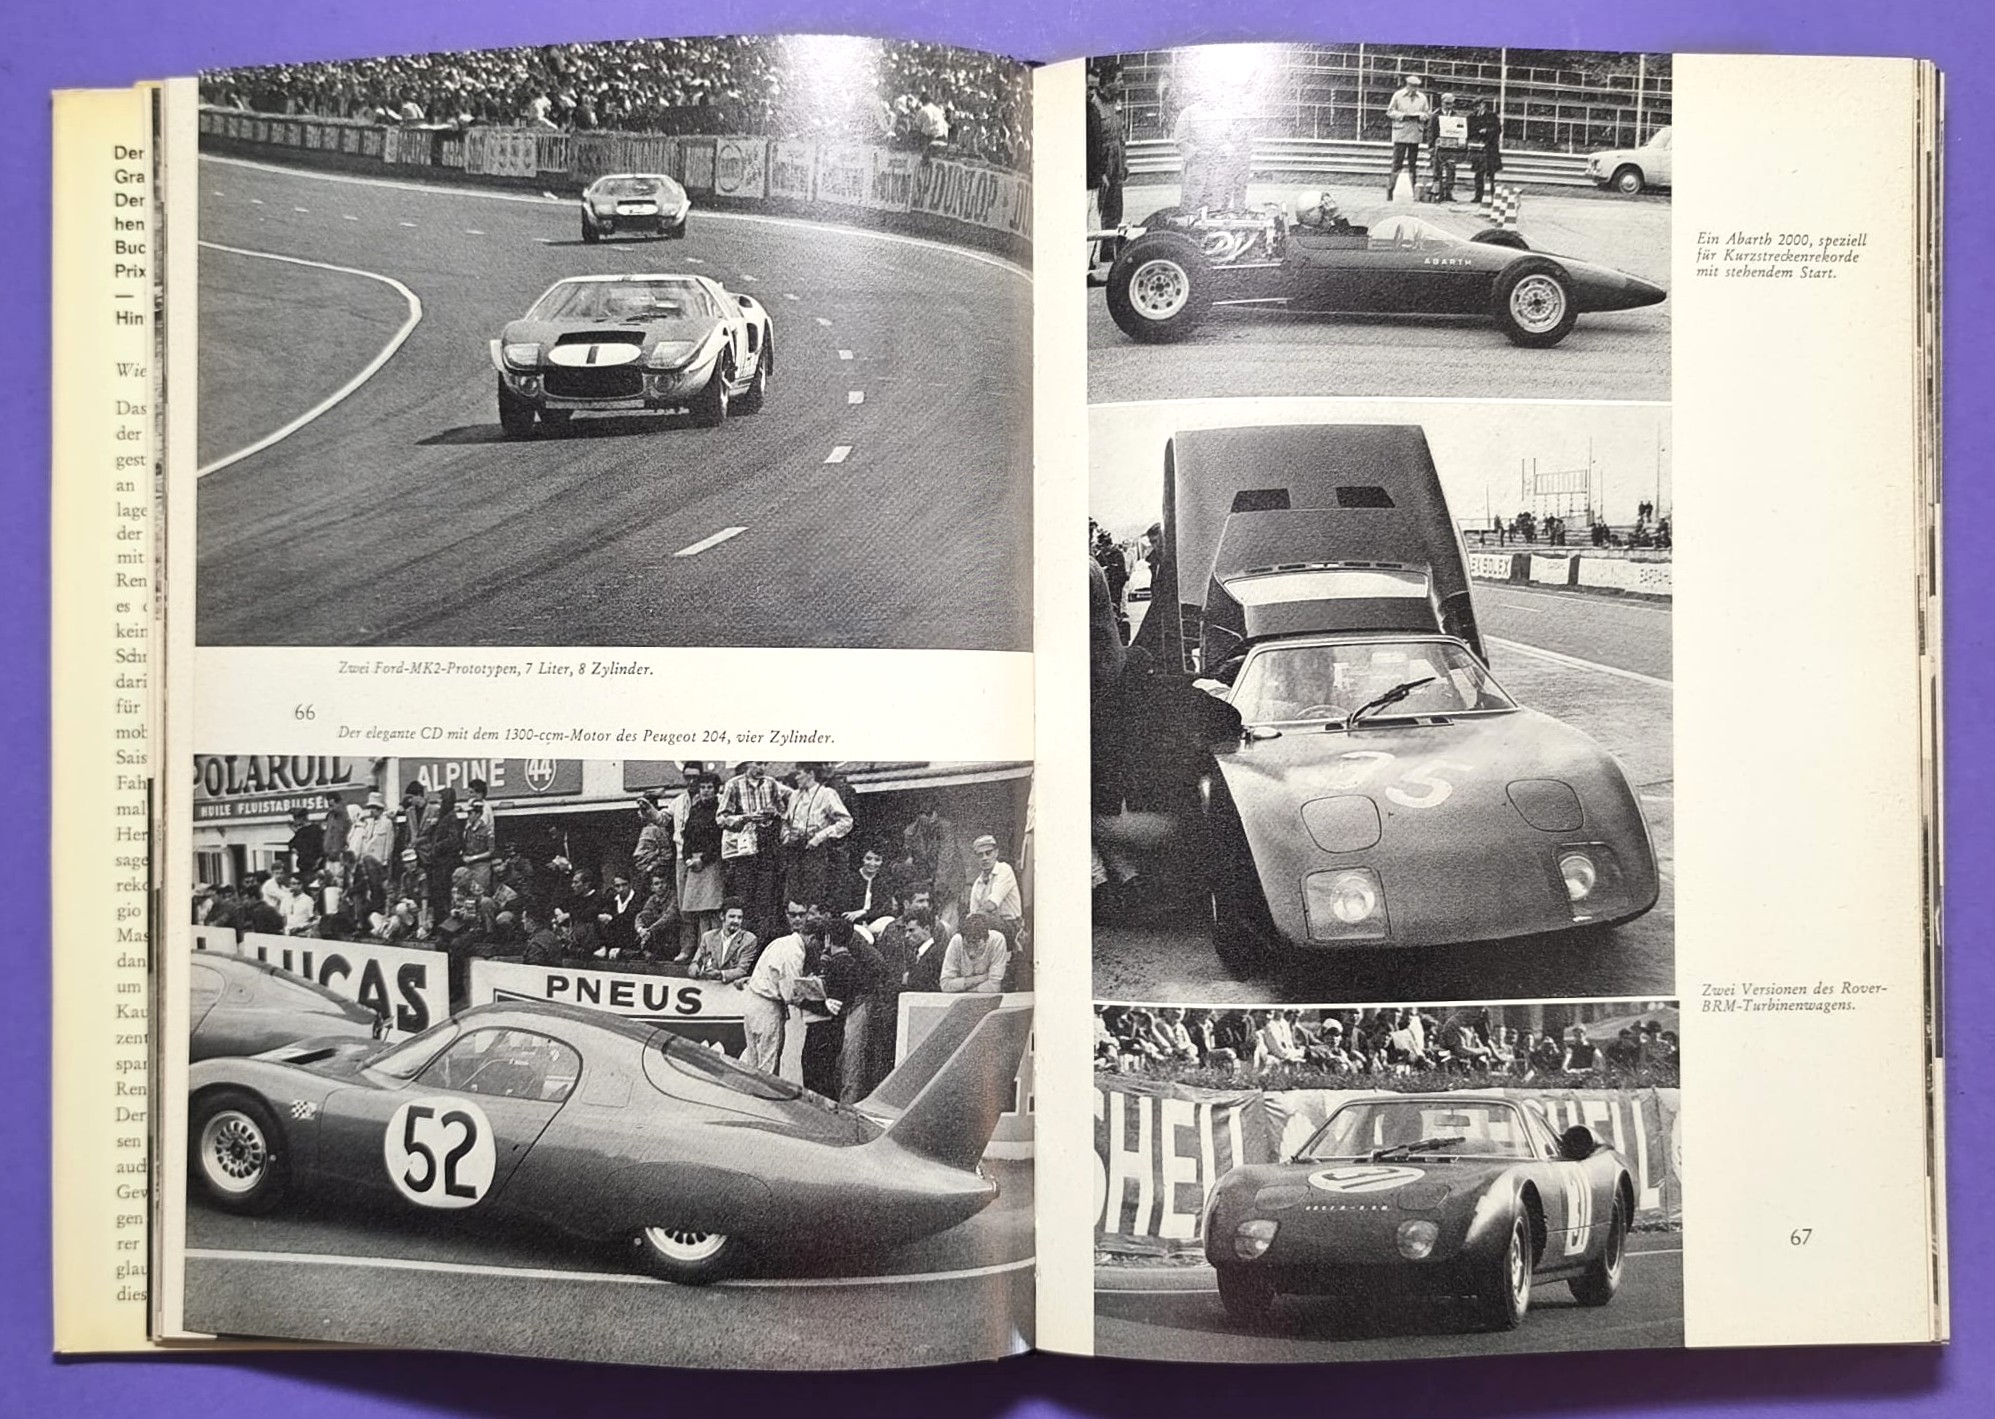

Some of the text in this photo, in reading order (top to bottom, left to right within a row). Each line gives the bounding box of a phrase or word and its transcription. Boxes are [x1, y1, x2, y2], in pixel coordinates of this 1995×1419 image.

[115, 145, 145, 160] Der
[115, 169, 145, 184] Gra
[115, 192, 145, 207] Der
[115, 216, 145, 231] hen
[115, 240, 146, 255] Buc
[1697, 231, 1868, 249] Ein Abarth 2000, speziell
[1696, 248, 1860, 263] für Kurzstreckenrekorde
[115, 264, 147, 278] Prix
[1696, 264, 1838, 279] mit stehendem Start.
[586, 346, 599, 364] 1
[116, 363, 147, 377] Wie
[116, 400, 147, 415] Das
[116, 425, 142, 440] der
[116, 456, 147, 471] gest
[116, 482, 135, 492] an
[116, 525, 143, 540] der
[116, 549, 144, 564] mit
[116, 573, 147, 587] Ren
[116, 603, 130, 613] es
[338, 660, 654, 679] Zwei Ford-MK2-Prototypen, 7 Liter, 8 Zylinder.
[116, 673, 147, 688] dari
[116, 698, 140, 714] für
[295, 703, 316, 721] 66
[338, 725, 835, 746] Der elegante CD mit dem 1300-ccm-Motor des Peugeot 204, vier Zylinder.
[116, 749, 147, 764] Sais
[417, 758, 505, 793] ALPINE
[528, 759, 552, 782] 44
[116, 775, 147, 790] Fah
[116, 800, 146, 816] mal
[201, 803, 232, 818] HUILE
[116, 856, 149, 871] sage
[116, 903, 142, 922] gio
[116, 928, 149, 943] Mas
[116, 952, 146, 968] dan
[116, 982, 141, 993] um
[546, 975, 703, 1015] PNEUS
[1701, 981, 1888, 997] Zwei Versionen des Rover-
[116, 1004, 148, 1018] Kau
[1701, 998, 1857, 1014] BRM-Turbinenwagens.
[116, 1081, 147, 1096] Ren
[116, 1107, 147, 1122] Der
[116, 1137, 141, 1148] sen
[403, 1105, 478, 1199] 52
[116, 1214, 143, 1230] gen
[116, 1239, 140, 1250] rer
[1790, 1228, 1813, 1246] 67
[116, 1260, 147, 1280] glau
[116, 1286, 147, 1301] dies
